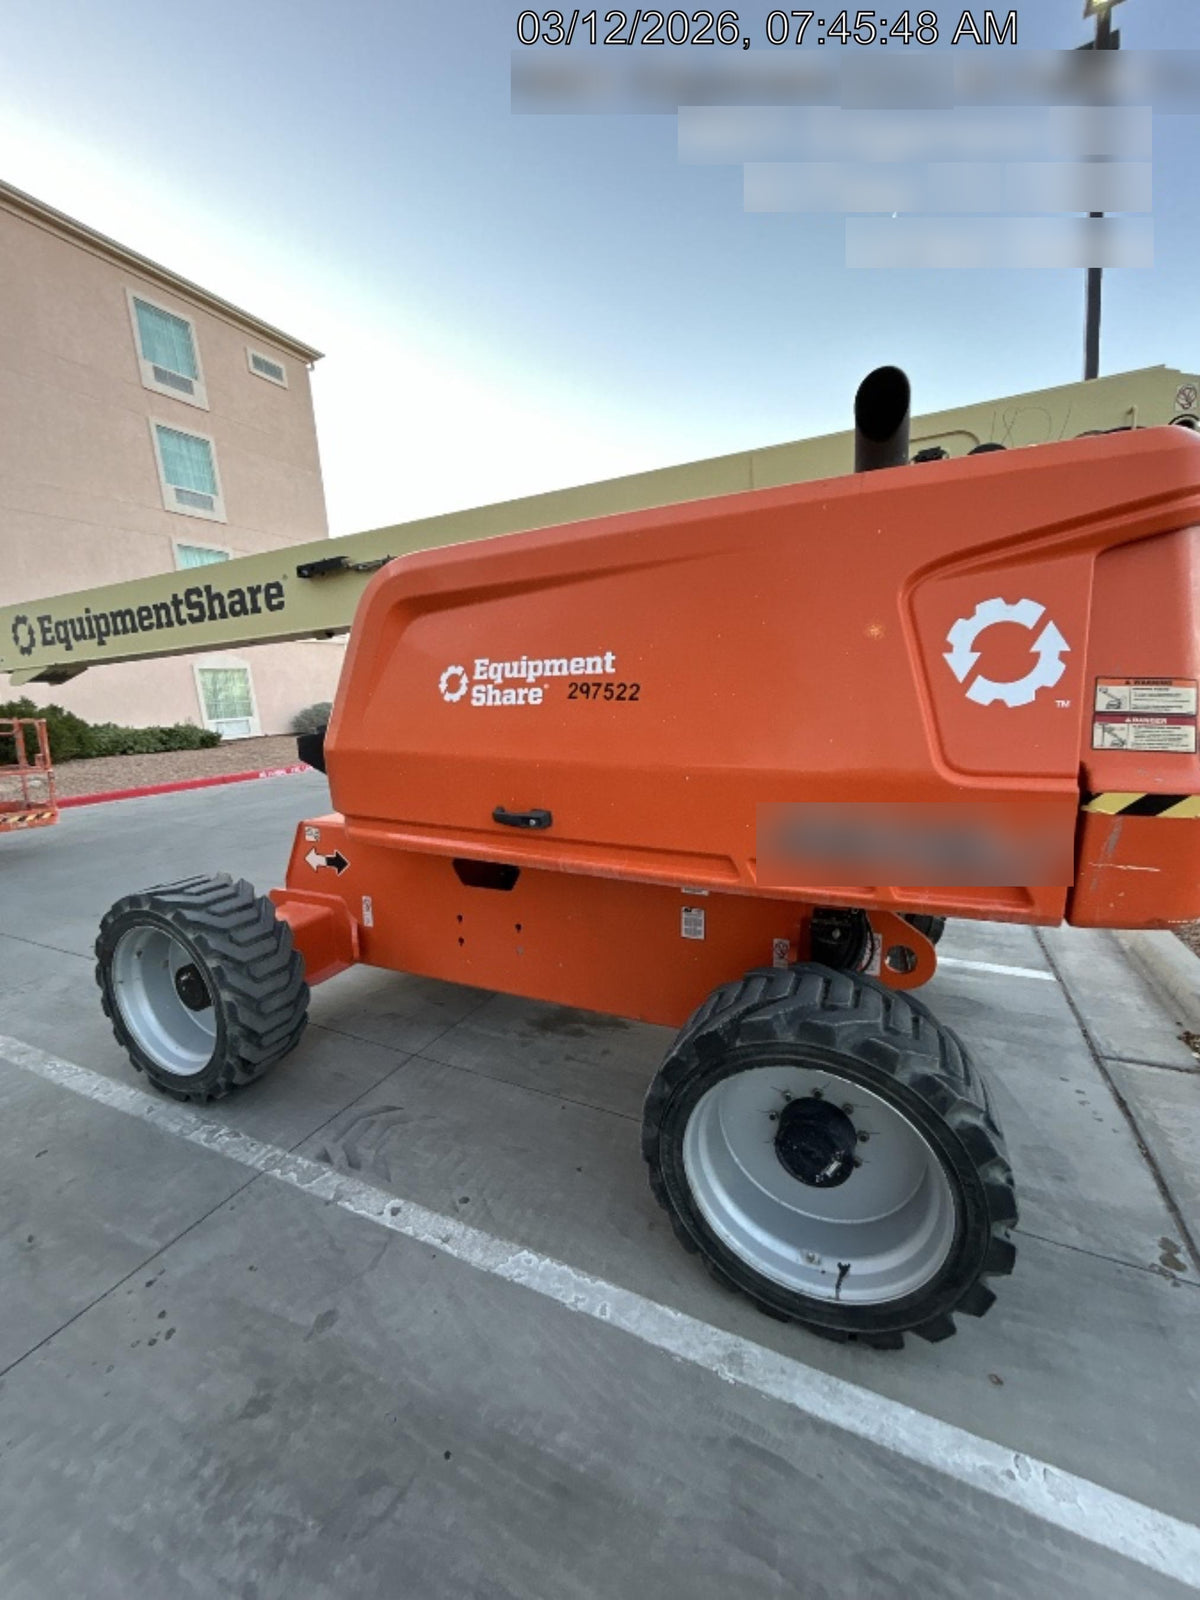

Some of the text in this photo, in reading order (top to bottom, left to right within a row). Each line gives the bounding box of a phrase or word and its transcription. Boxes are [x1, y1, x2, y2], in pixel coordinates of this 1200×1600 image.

[38, 581, 285, 650] EquipmentShare
[473, 650, 616, 684] Equipment
[471, 683, 543, 707] Share
[567, 682, 641, 702] 297522
